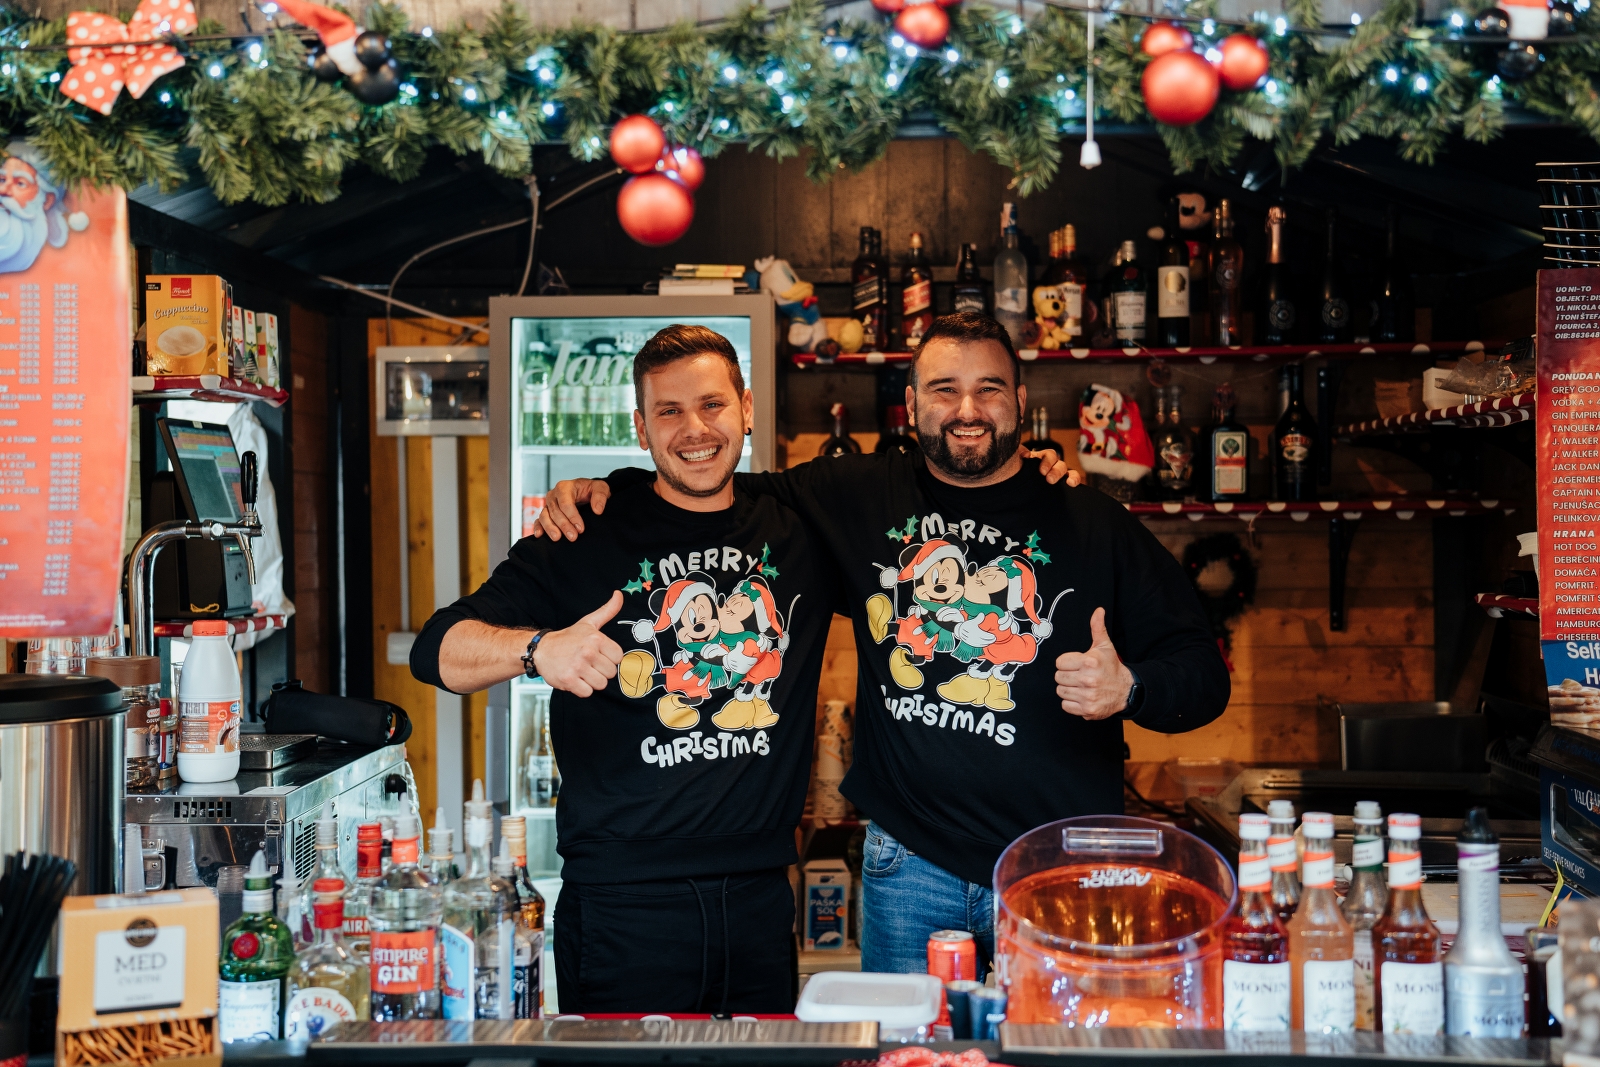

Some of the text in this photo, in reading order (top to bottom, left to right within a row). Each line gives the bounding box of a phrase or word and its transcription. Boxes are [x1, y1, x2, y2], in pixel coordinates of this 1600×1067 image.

[154, 303, 208, 320] Cappuccino
[921, 512, 1020, 552] MERRY
[659, 546, 758, 586] MERRY
[1555, 567, 1597, 576] DOMAĆA
[1563, 859, 1585, 879] PANCAKES
[1079, 872, 1152, 888] APEROL
[810, 896, 842, 906] PAŠKA
[115, 952, 167, 973] MED
[378, 965, 419, 984] GIN
[1232, 981, 1288, 993] MONIN
